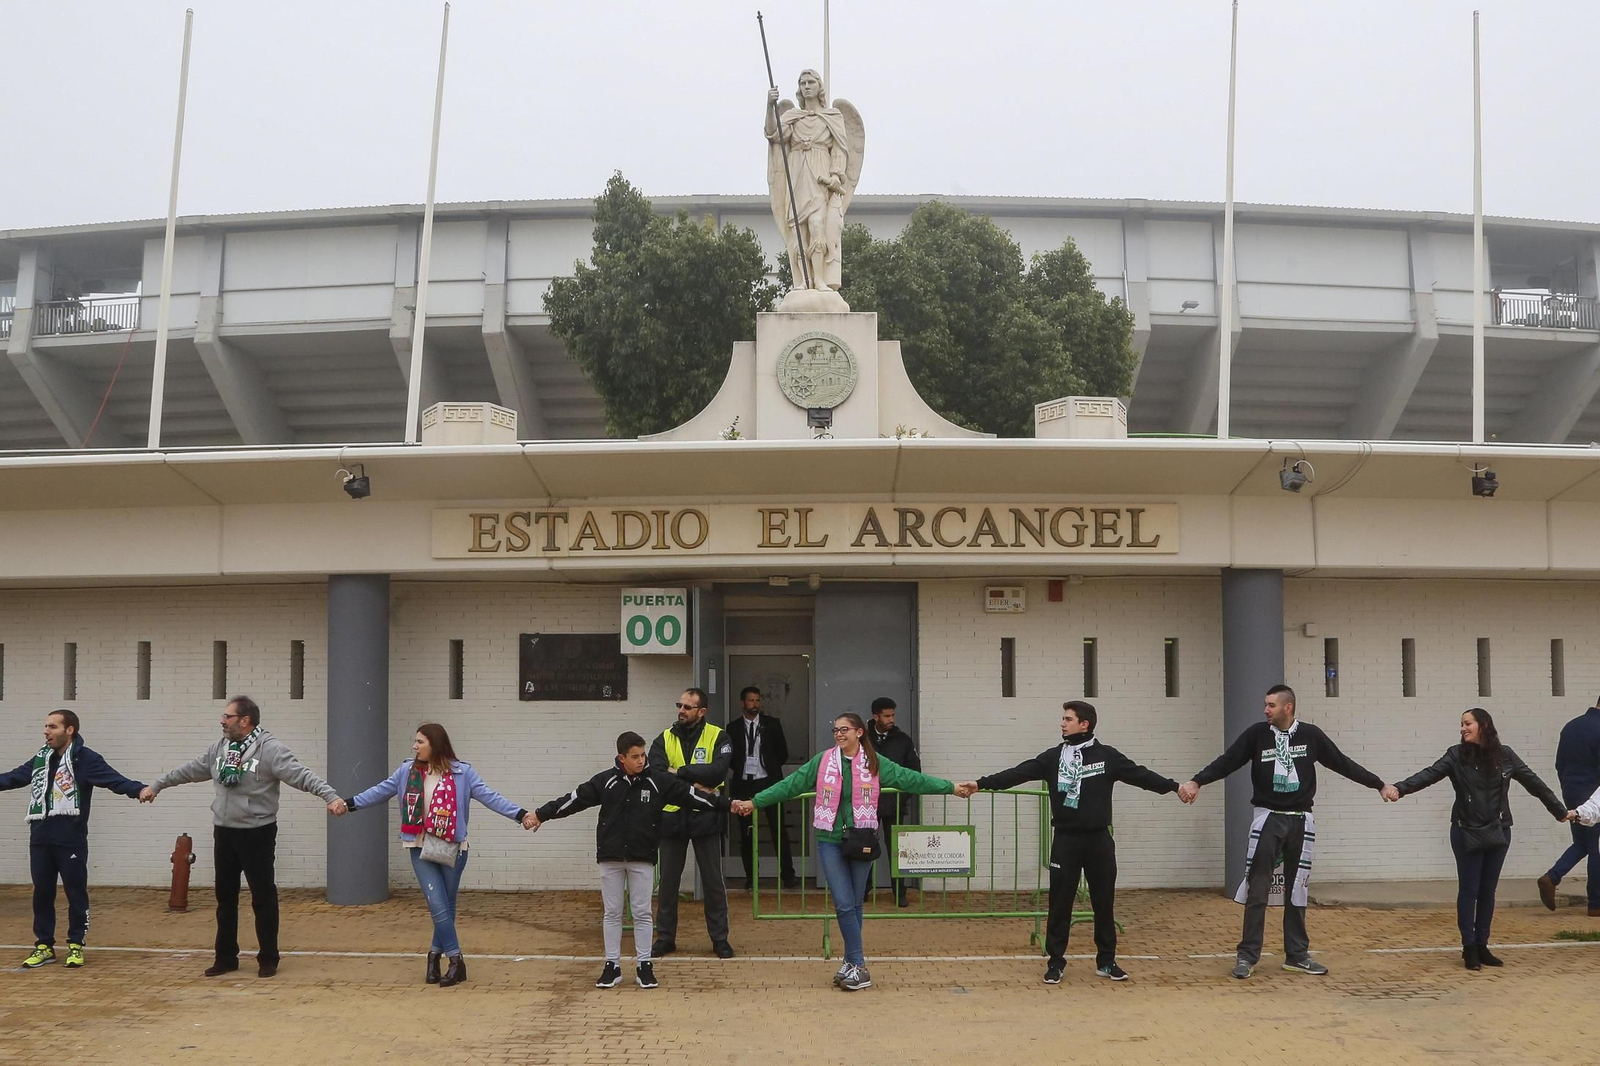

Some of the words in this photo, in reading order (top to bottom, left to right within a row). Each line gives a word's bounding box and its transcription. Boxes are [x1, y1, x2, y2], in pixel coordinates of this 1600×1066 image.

[468, 508, 708, 552] ESTADIO
[757, 507, 829, 548] EL
[851, 506, 1161, 548] ARCANGEL
[622, 594, 685, 607] PUERTA
[625, 614, 682, 647] 00
